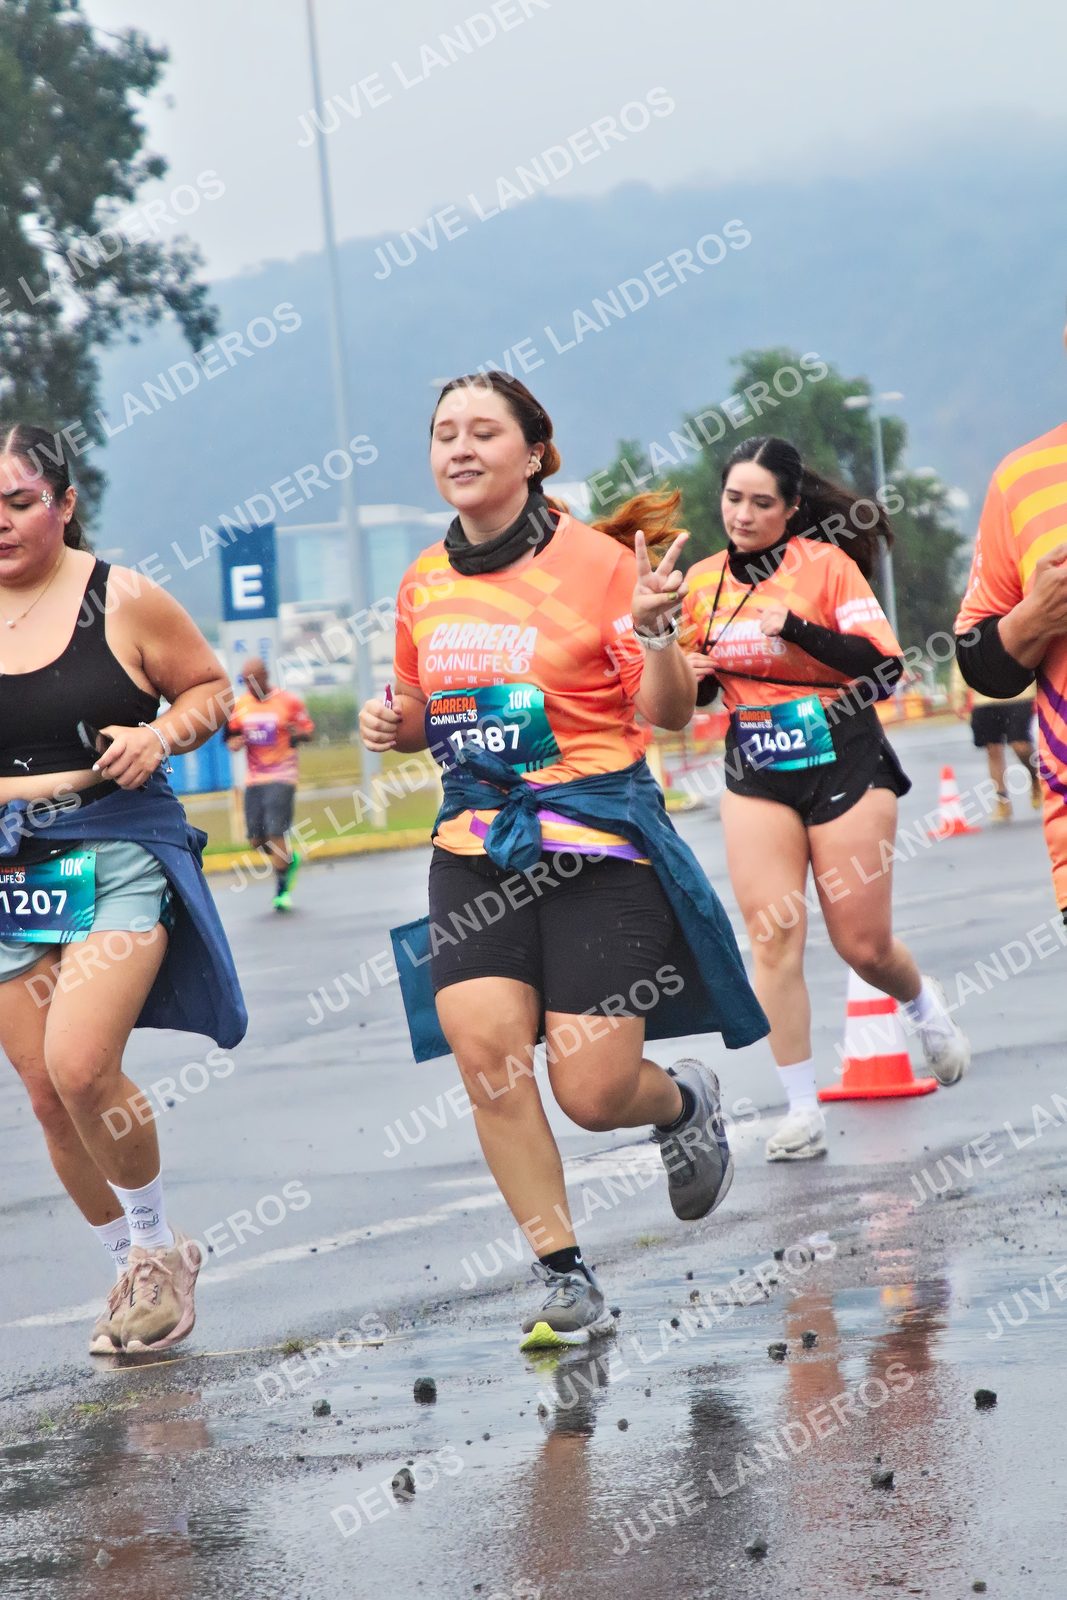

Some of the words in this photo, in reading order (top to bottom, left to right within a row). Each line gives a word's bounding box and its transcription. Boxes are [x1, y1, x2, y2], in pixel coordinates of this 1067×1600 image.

[230, 564, 265, 610] E
[429, 623, 538, 653] CARRERA
[430, 696, 478, 715] CARRERA
[508, 690, 533, 710] 10K
[796, 701, 815, 717] 10K
[450, 724, 520, 753] 1387
[751, 729, 806, 752] 1402
[59, 858, 84, 876] 10K
[0, 889, 68, 915] 1207
